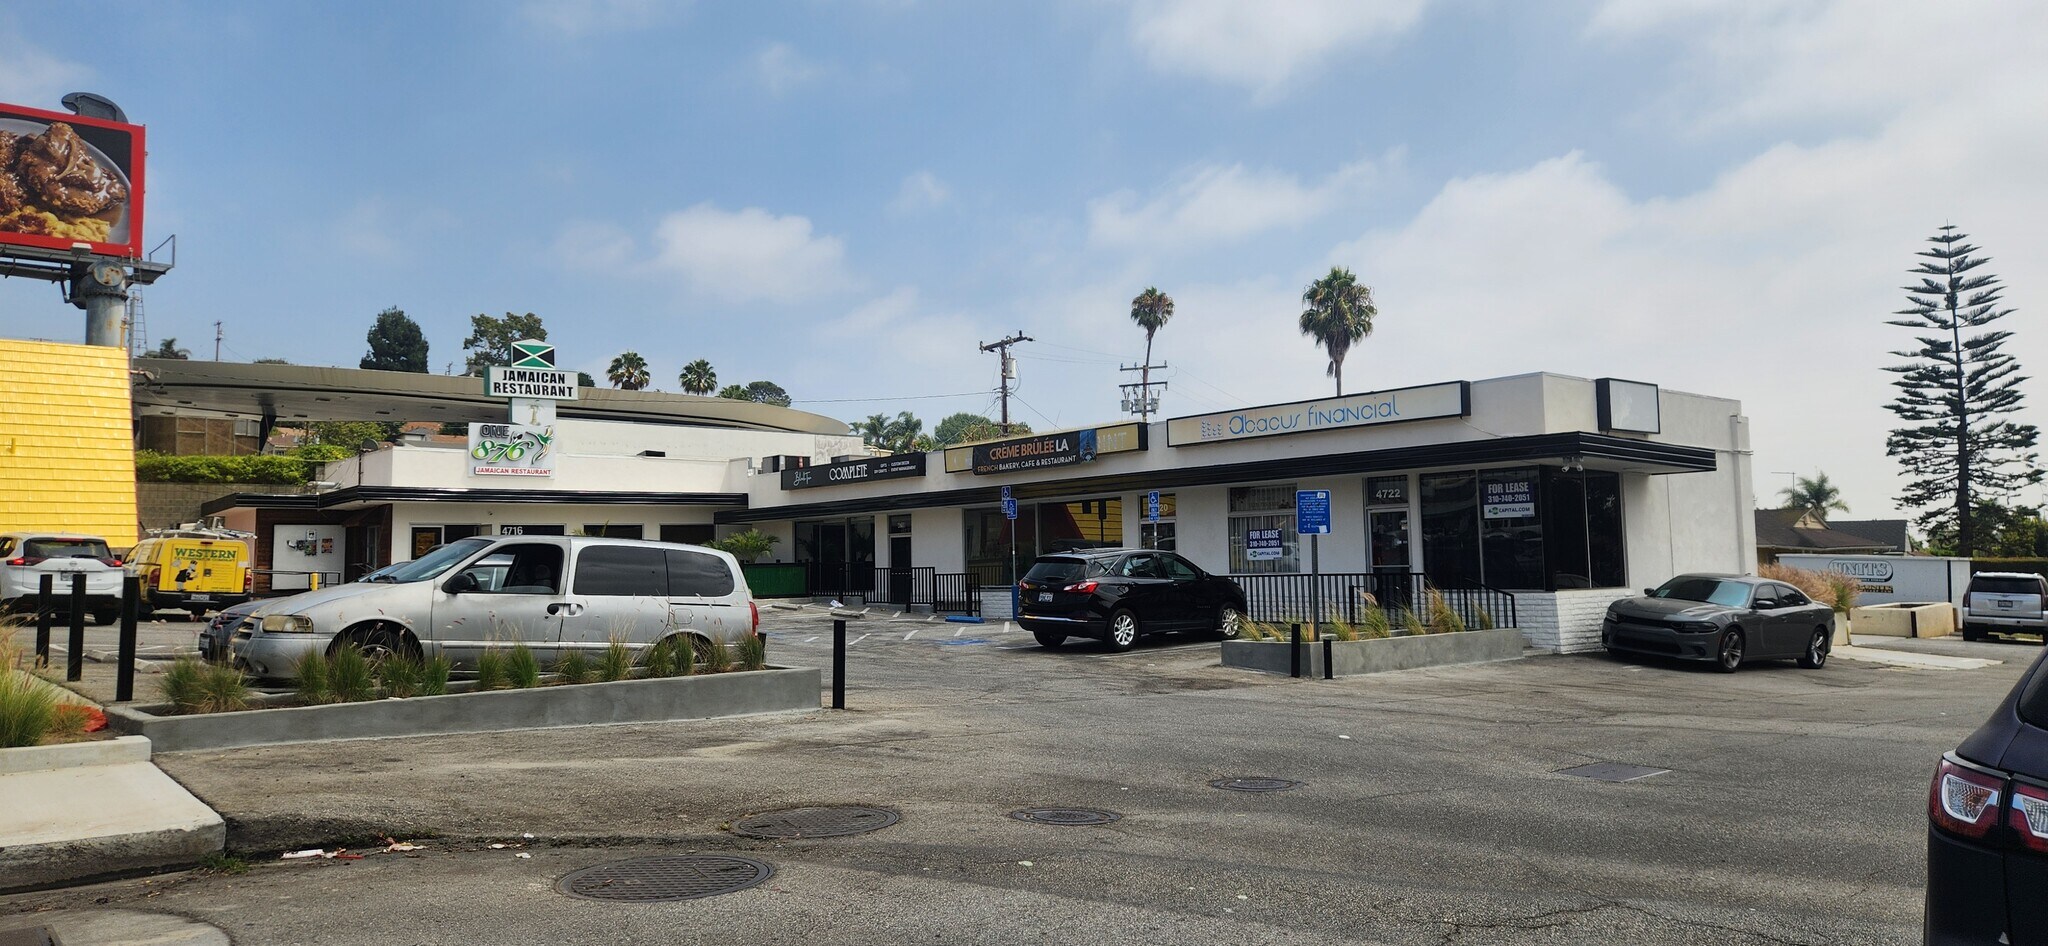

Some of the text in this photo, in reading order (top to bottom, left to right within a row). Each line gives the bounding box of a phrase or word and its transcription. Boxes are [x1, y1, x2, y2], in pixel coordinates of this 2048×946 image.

[503, 370, 565, 384] JAMAICAN
[494, 382, 573, 397] RESTAURANT
[1229, 395, 1400, 434] abacus financial
[480, 424, 510, 438] ONE
[472, 439, 535, 464] 876
[989, 443, 1020, 461] CRÈME
[1021, 437, 1055, 457] BRÛLÉE
[1055, 438, 1069, 452] LA
[977, 464, 999, 473] FRENCH
[999, 461, 1021, 471] BAKERY,
[1021, 460, 1035, 468] CAFE
[1041, 455, 1077, 466] RESTAURANT
[829, 464, 868, 480] COMPLETE
[1376, 489, 1401, 499] 4722
[1488, 482, 1529, 494] FOR LEASE
[501, 526, 523, 536] 4716
[1249, 529, 1279, 539] FOR LEASE
[174, 547, 237, 559] WESTERN
[1832, 562, 1887, 576] UNITS
